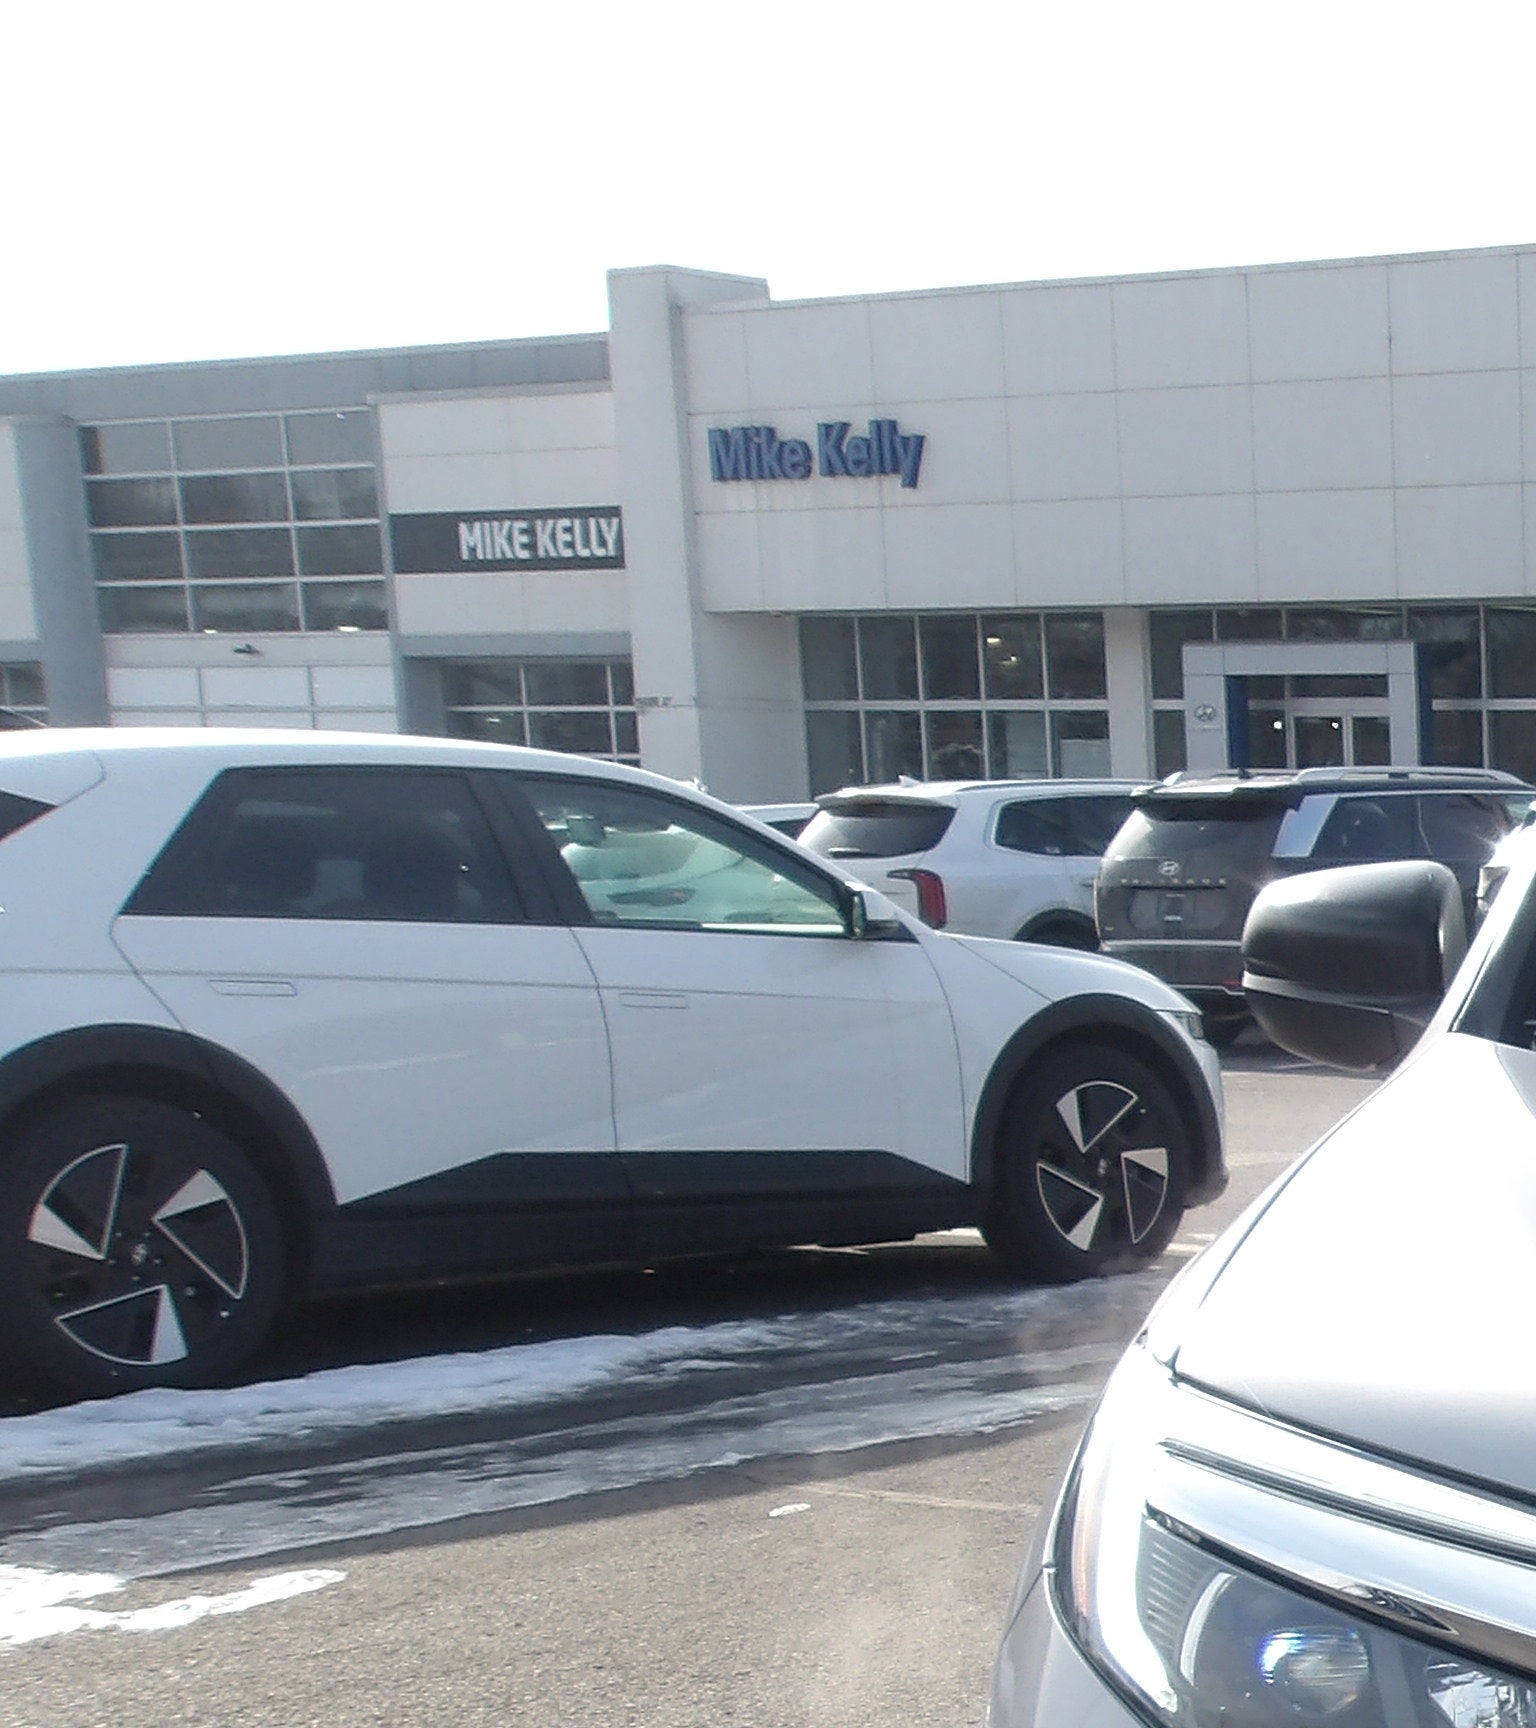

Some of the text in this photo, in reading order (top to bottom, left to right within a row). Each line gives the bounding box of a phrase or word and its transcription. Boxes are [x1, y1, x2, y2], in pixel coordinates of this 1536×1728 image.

[708, 419, 926, 489] Mike Kelly
[458, 516, 620, 561] MIKE KELLY
